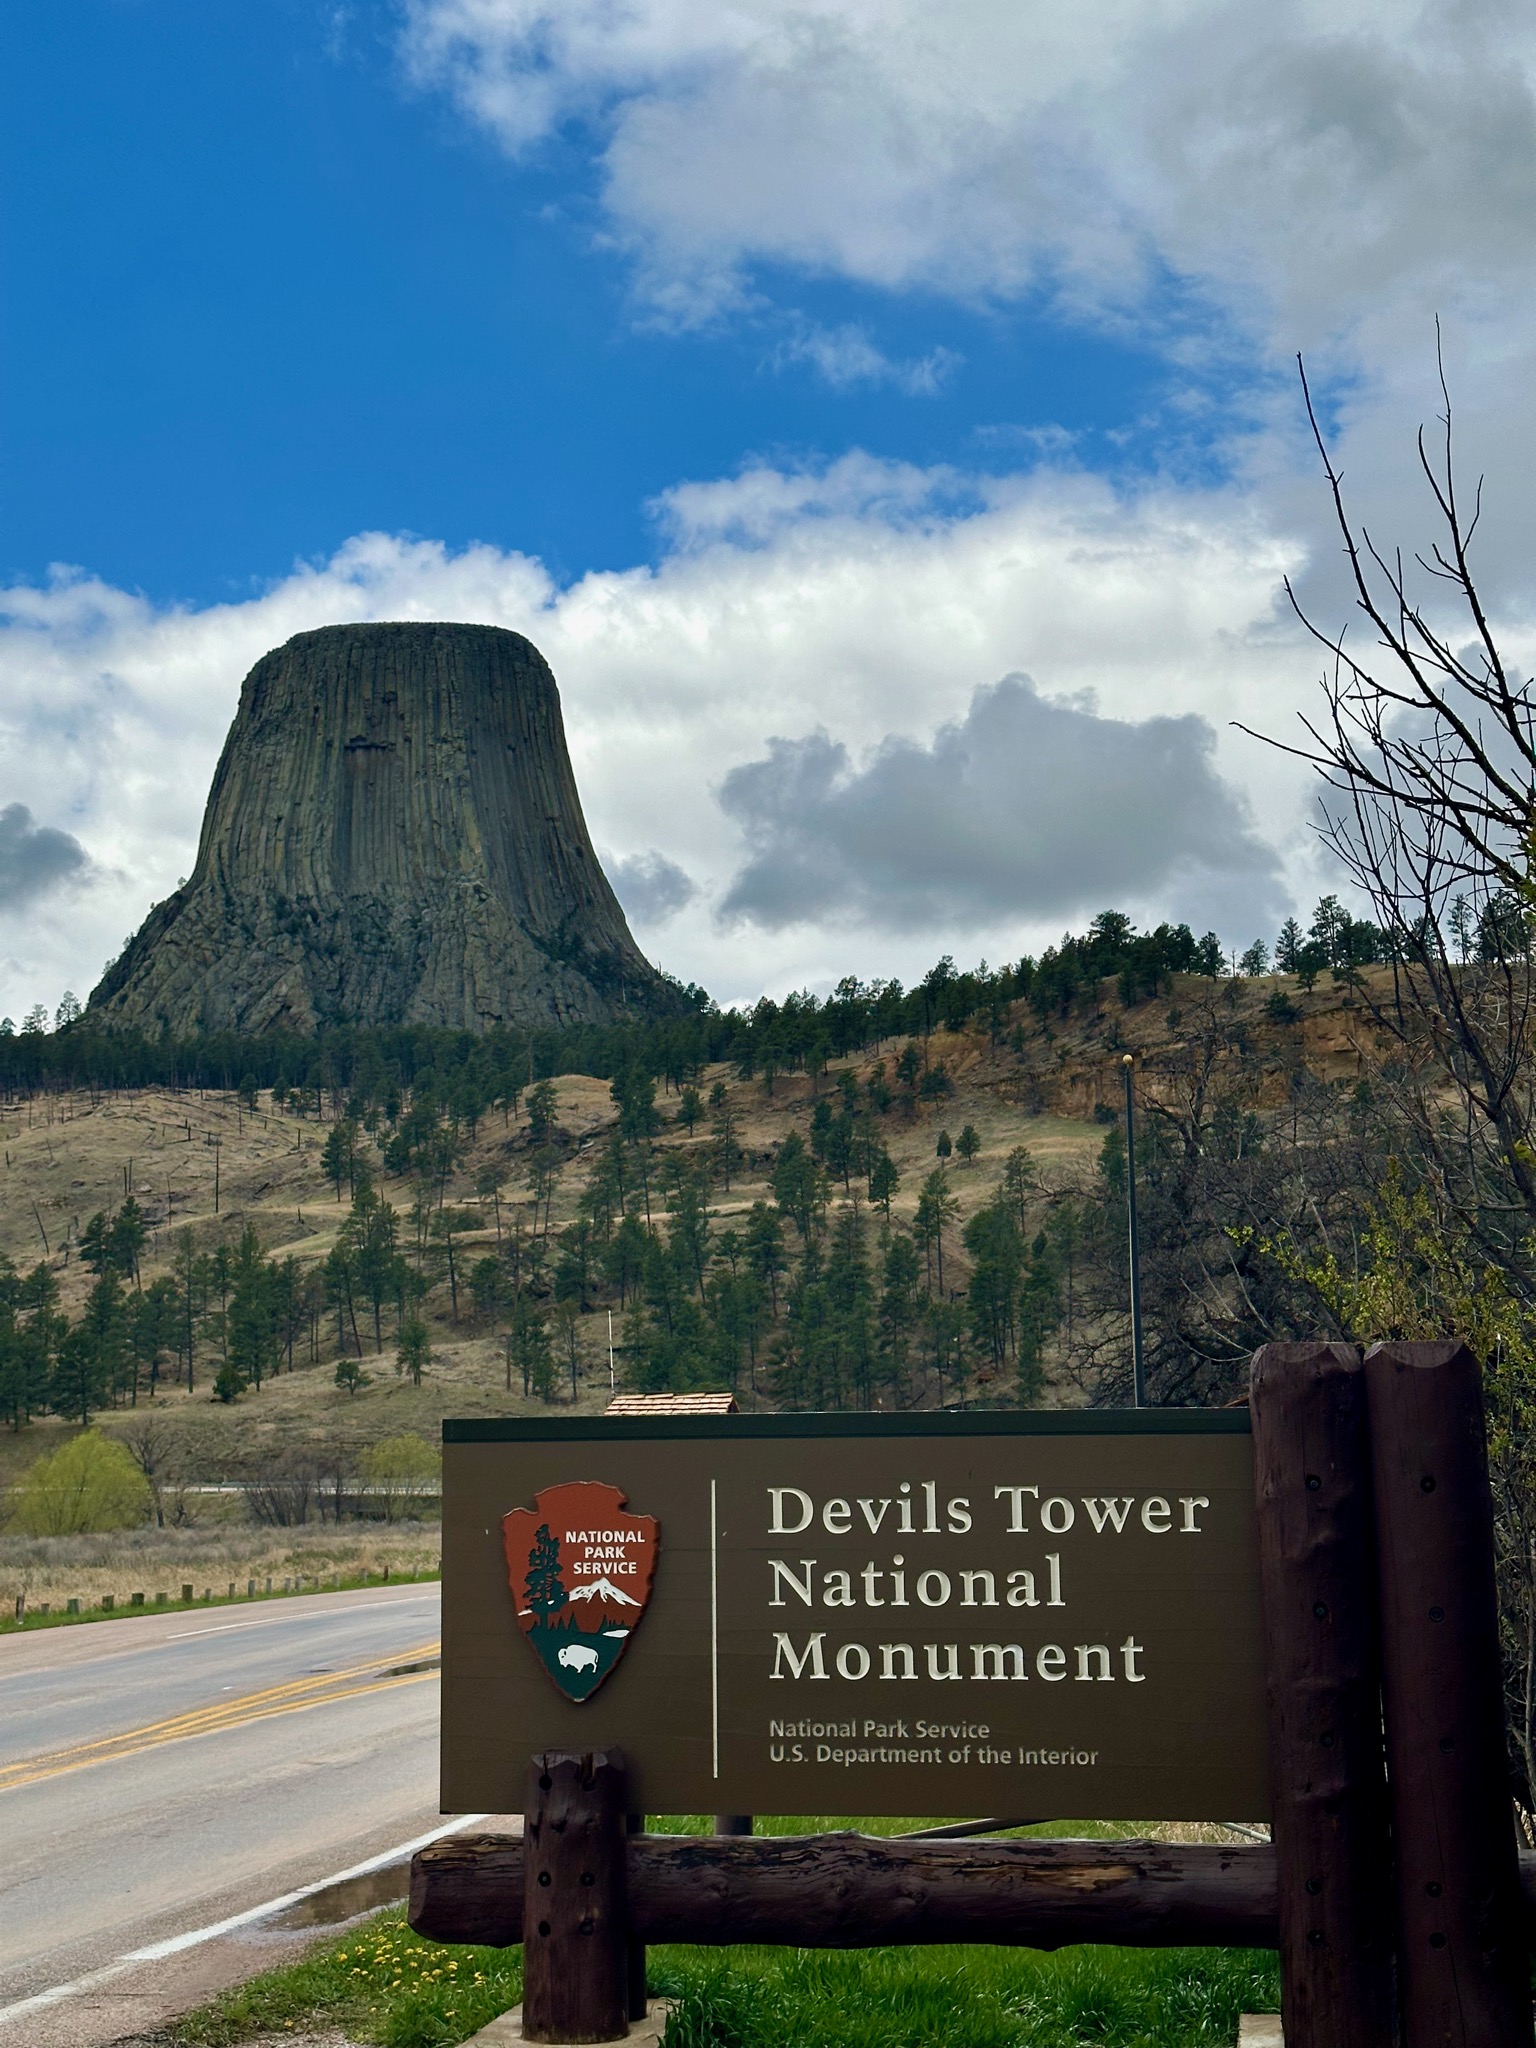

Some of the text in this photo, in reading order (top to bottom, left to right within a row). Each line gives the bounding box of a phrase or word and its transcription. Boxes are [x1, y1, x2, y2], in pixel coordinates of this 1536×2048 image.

[766, 1480, 1210, 1535] Devils Tower
[565, 1530, 646, 1543] NATIONAL
[584, 1546, 626, 1559] PARK
[573, 1561, 637, 1575] SERVICE
[767, 1552, 1066, 1607] National
[769, 1631, 1147, 1683] Monument
[769, 1718, 990, 1738] National Park Service
[769, 1744, 1099, 1767] U.S. Department of the Interior
